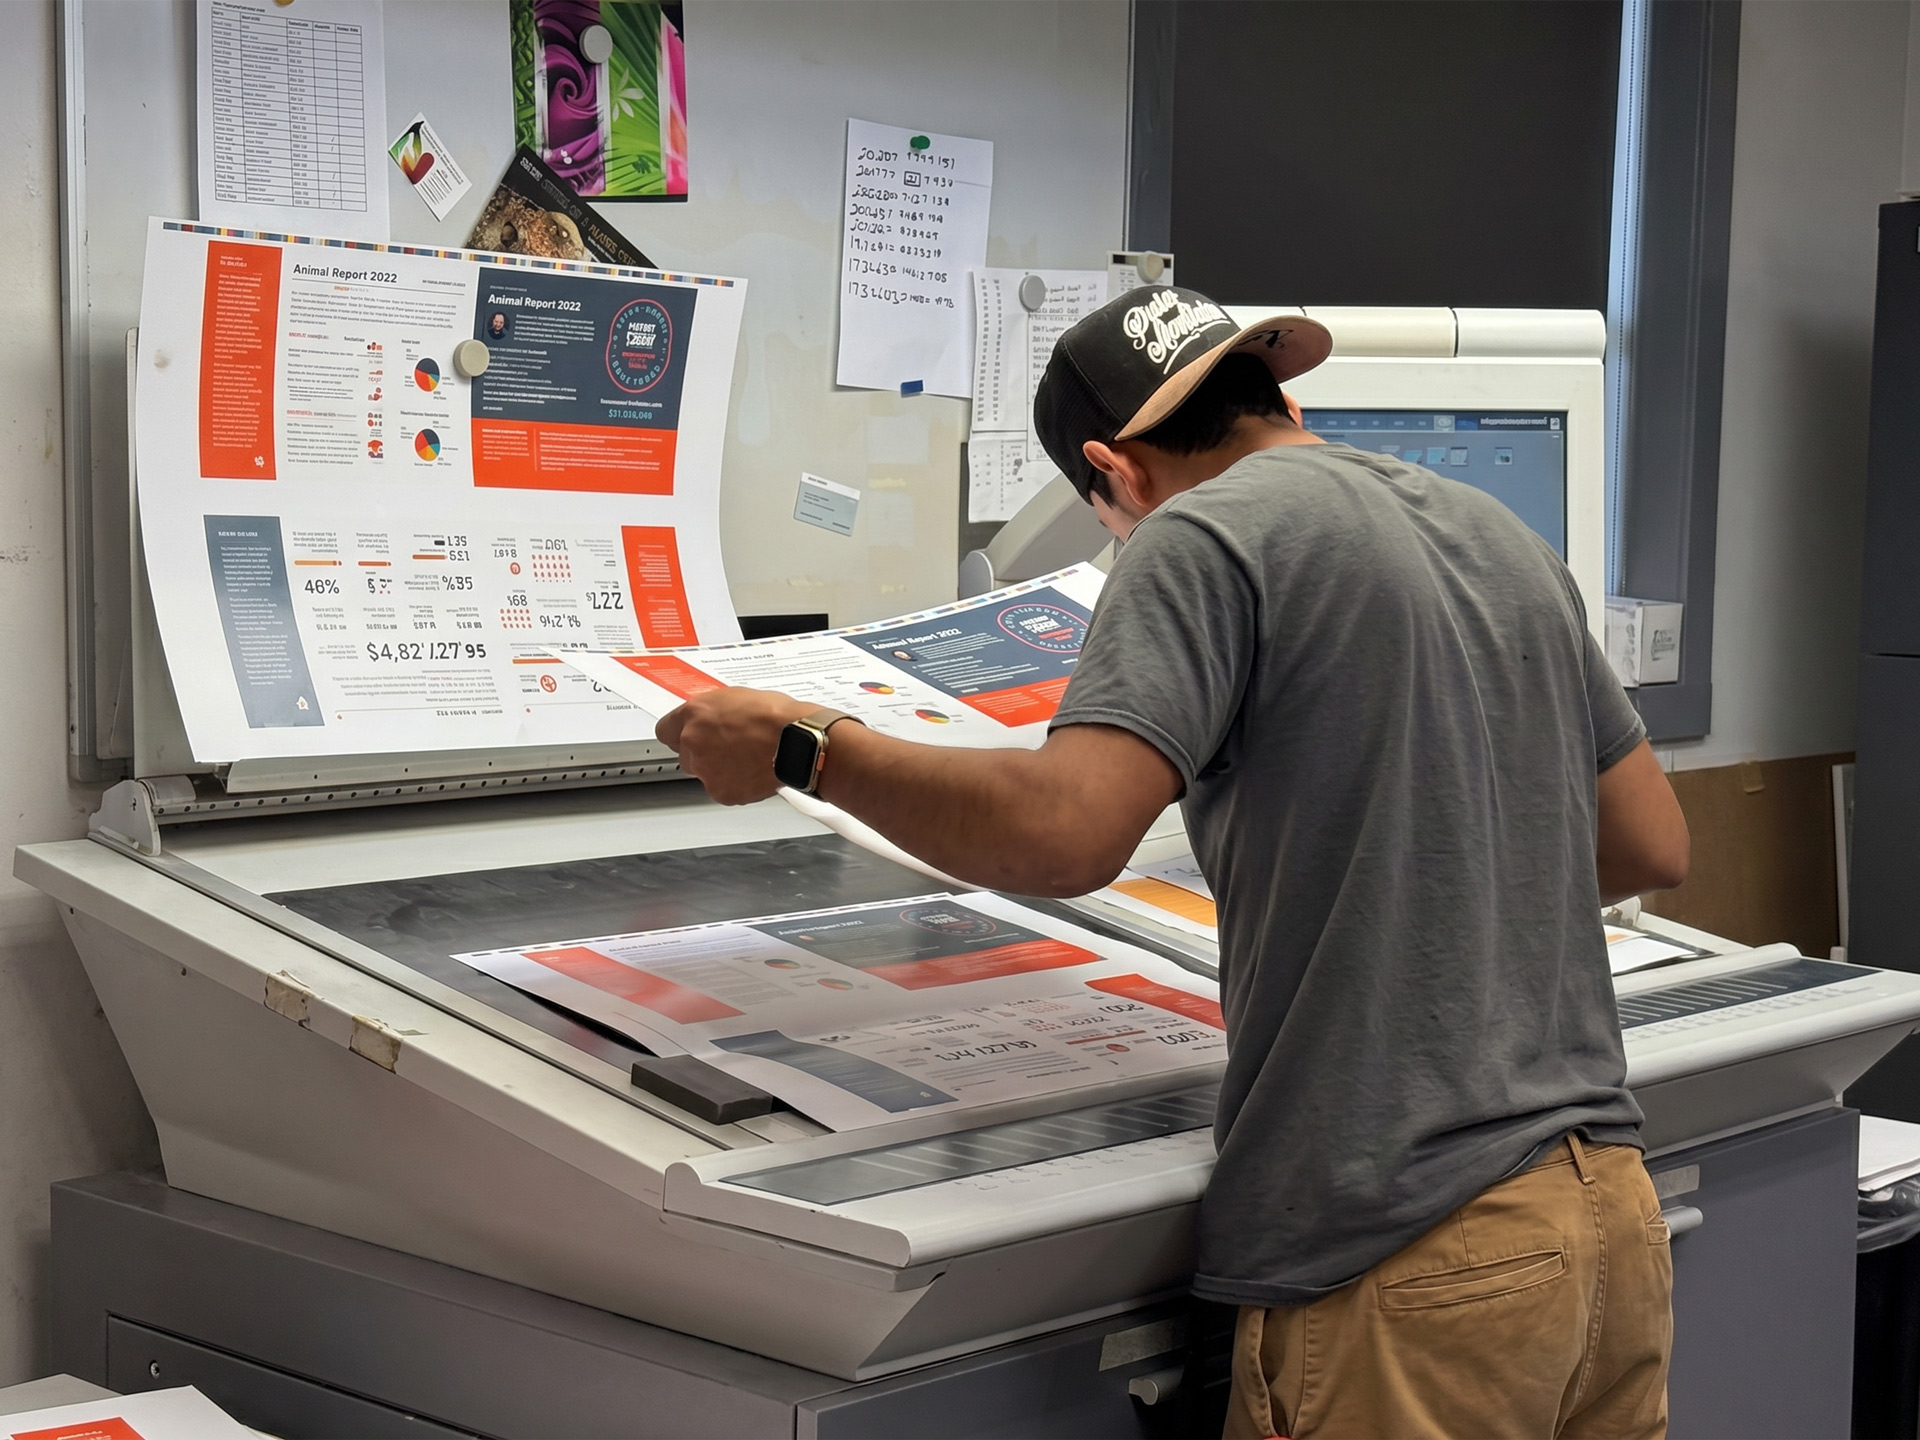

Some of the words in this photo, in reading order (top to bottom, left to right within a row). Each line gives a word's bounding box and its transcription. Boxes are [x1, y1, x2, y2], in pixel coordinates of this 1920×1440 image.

[293, 264, 329, 277] Animal
[331, 267, 368, 281] Report
[370, 271, 398, 284] 2022
[488, 294, 523, 307] Animal
[524, 297, 556, 310] Report
[557, 300, 581, 312] 2022
